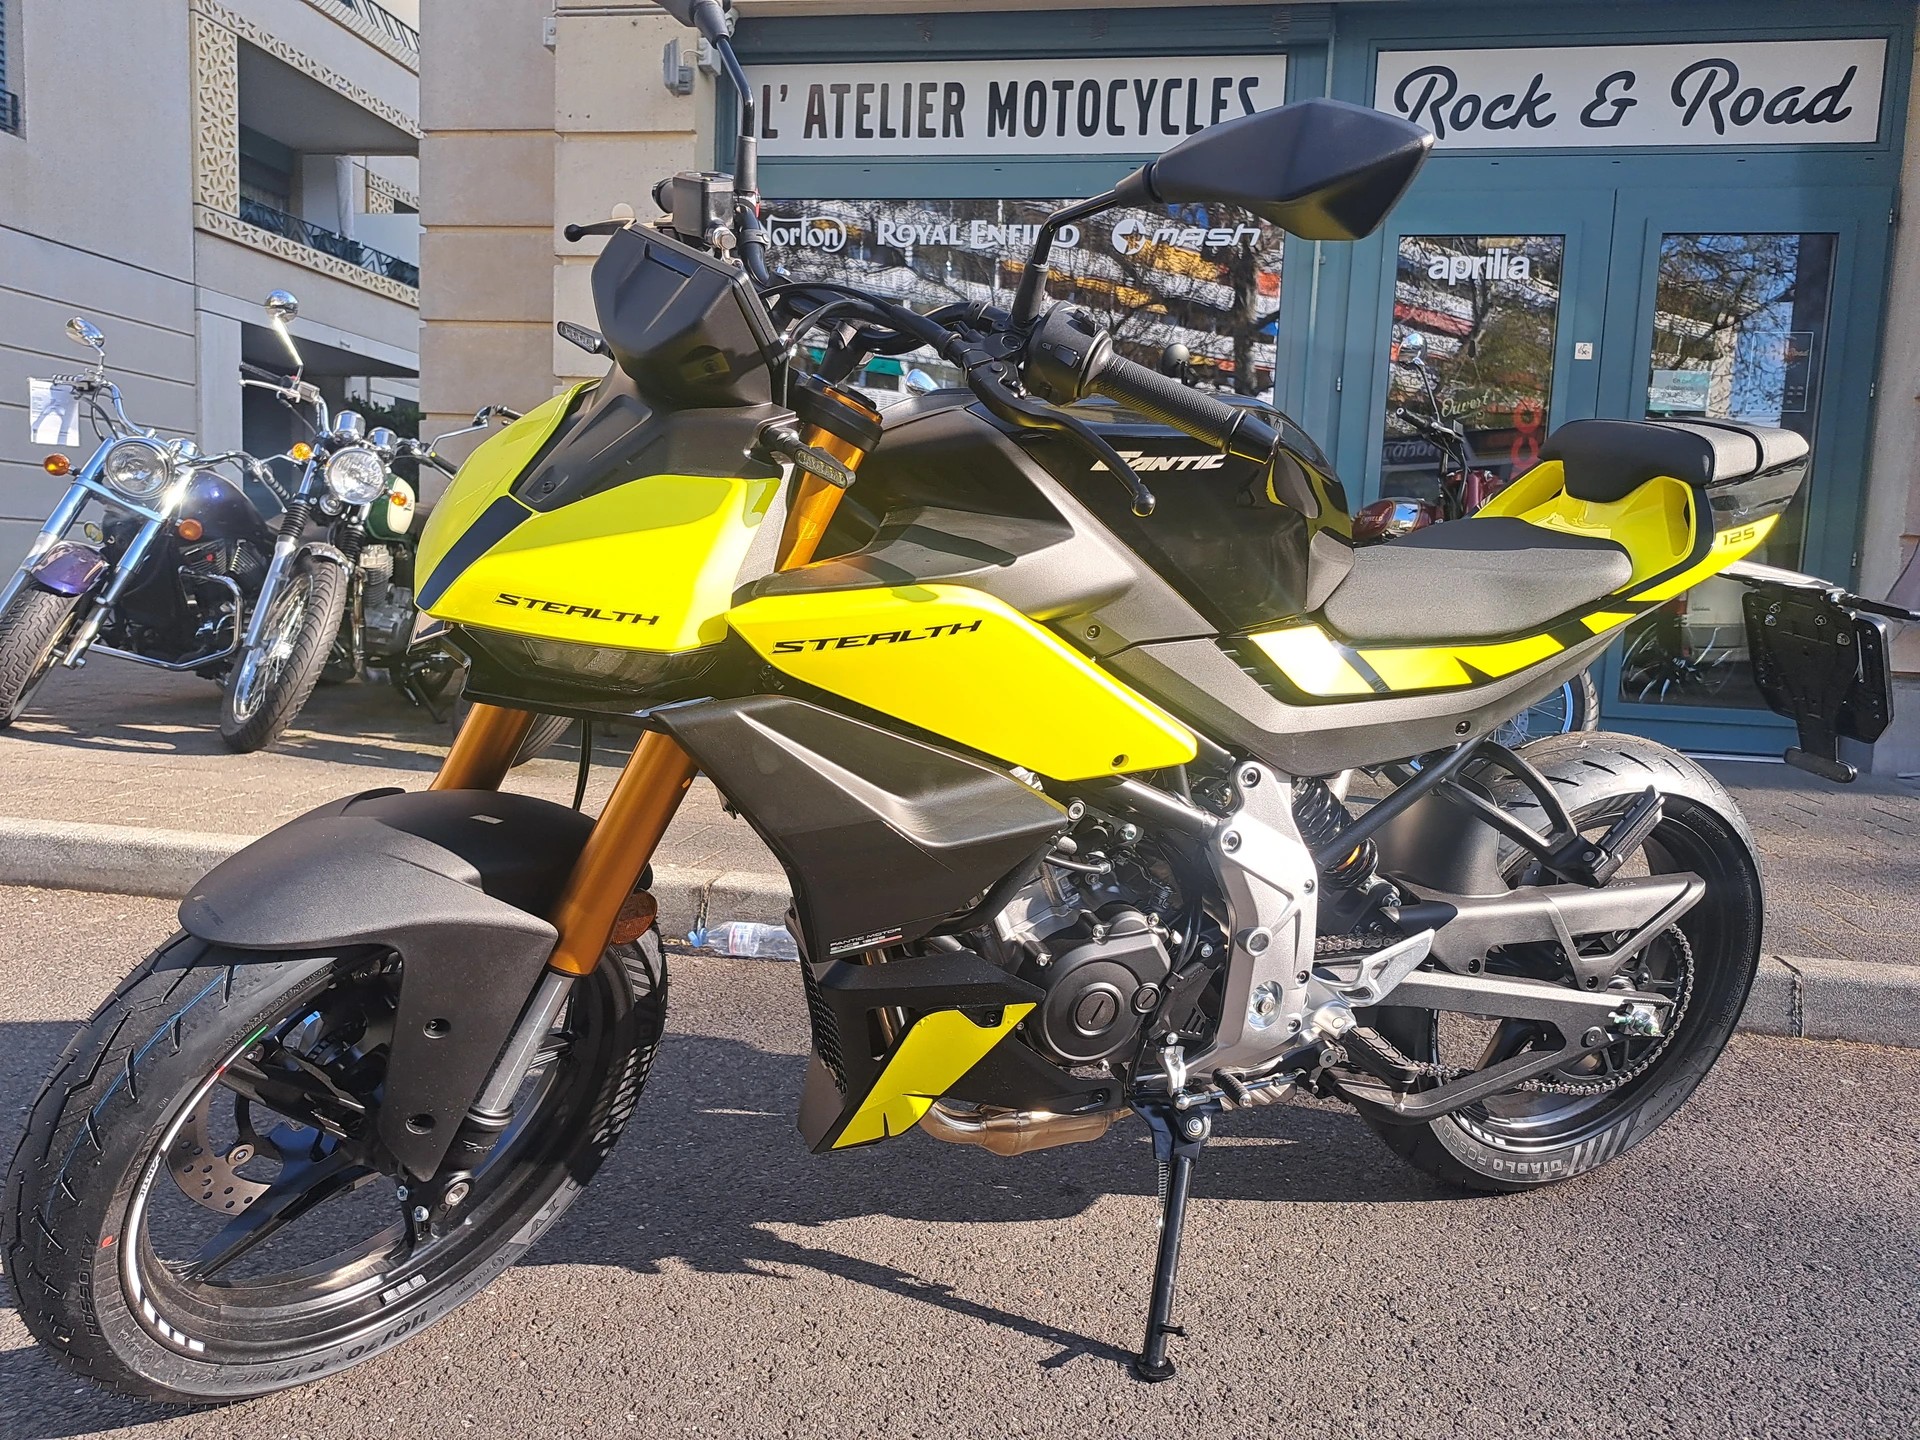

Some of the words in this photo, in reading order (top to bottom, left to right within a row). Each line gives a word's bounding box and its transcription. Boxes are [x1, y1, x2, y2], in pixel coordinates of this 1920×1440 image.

[803, 82, 965, 139] ATELIER
[1394, 65, 1557, 140] Rock
[1580, 70, 1638, 128] &
[1671, 58, 1858, 135] Road
[877, 221, 964, 248] ROYAL
[1428, 248, 1530, 286] aprilia
[1441, 391, 1490, 418] Ouvert
[1723, 527, 1755, 546] 125
[495, 592, 660, 626] STEALTH
[769, 619, 983, 655] STEALTH
[1442, 1125, 1489, 1166] ROSSO
[1492, 1157, 1563, 1175] DIABLO
